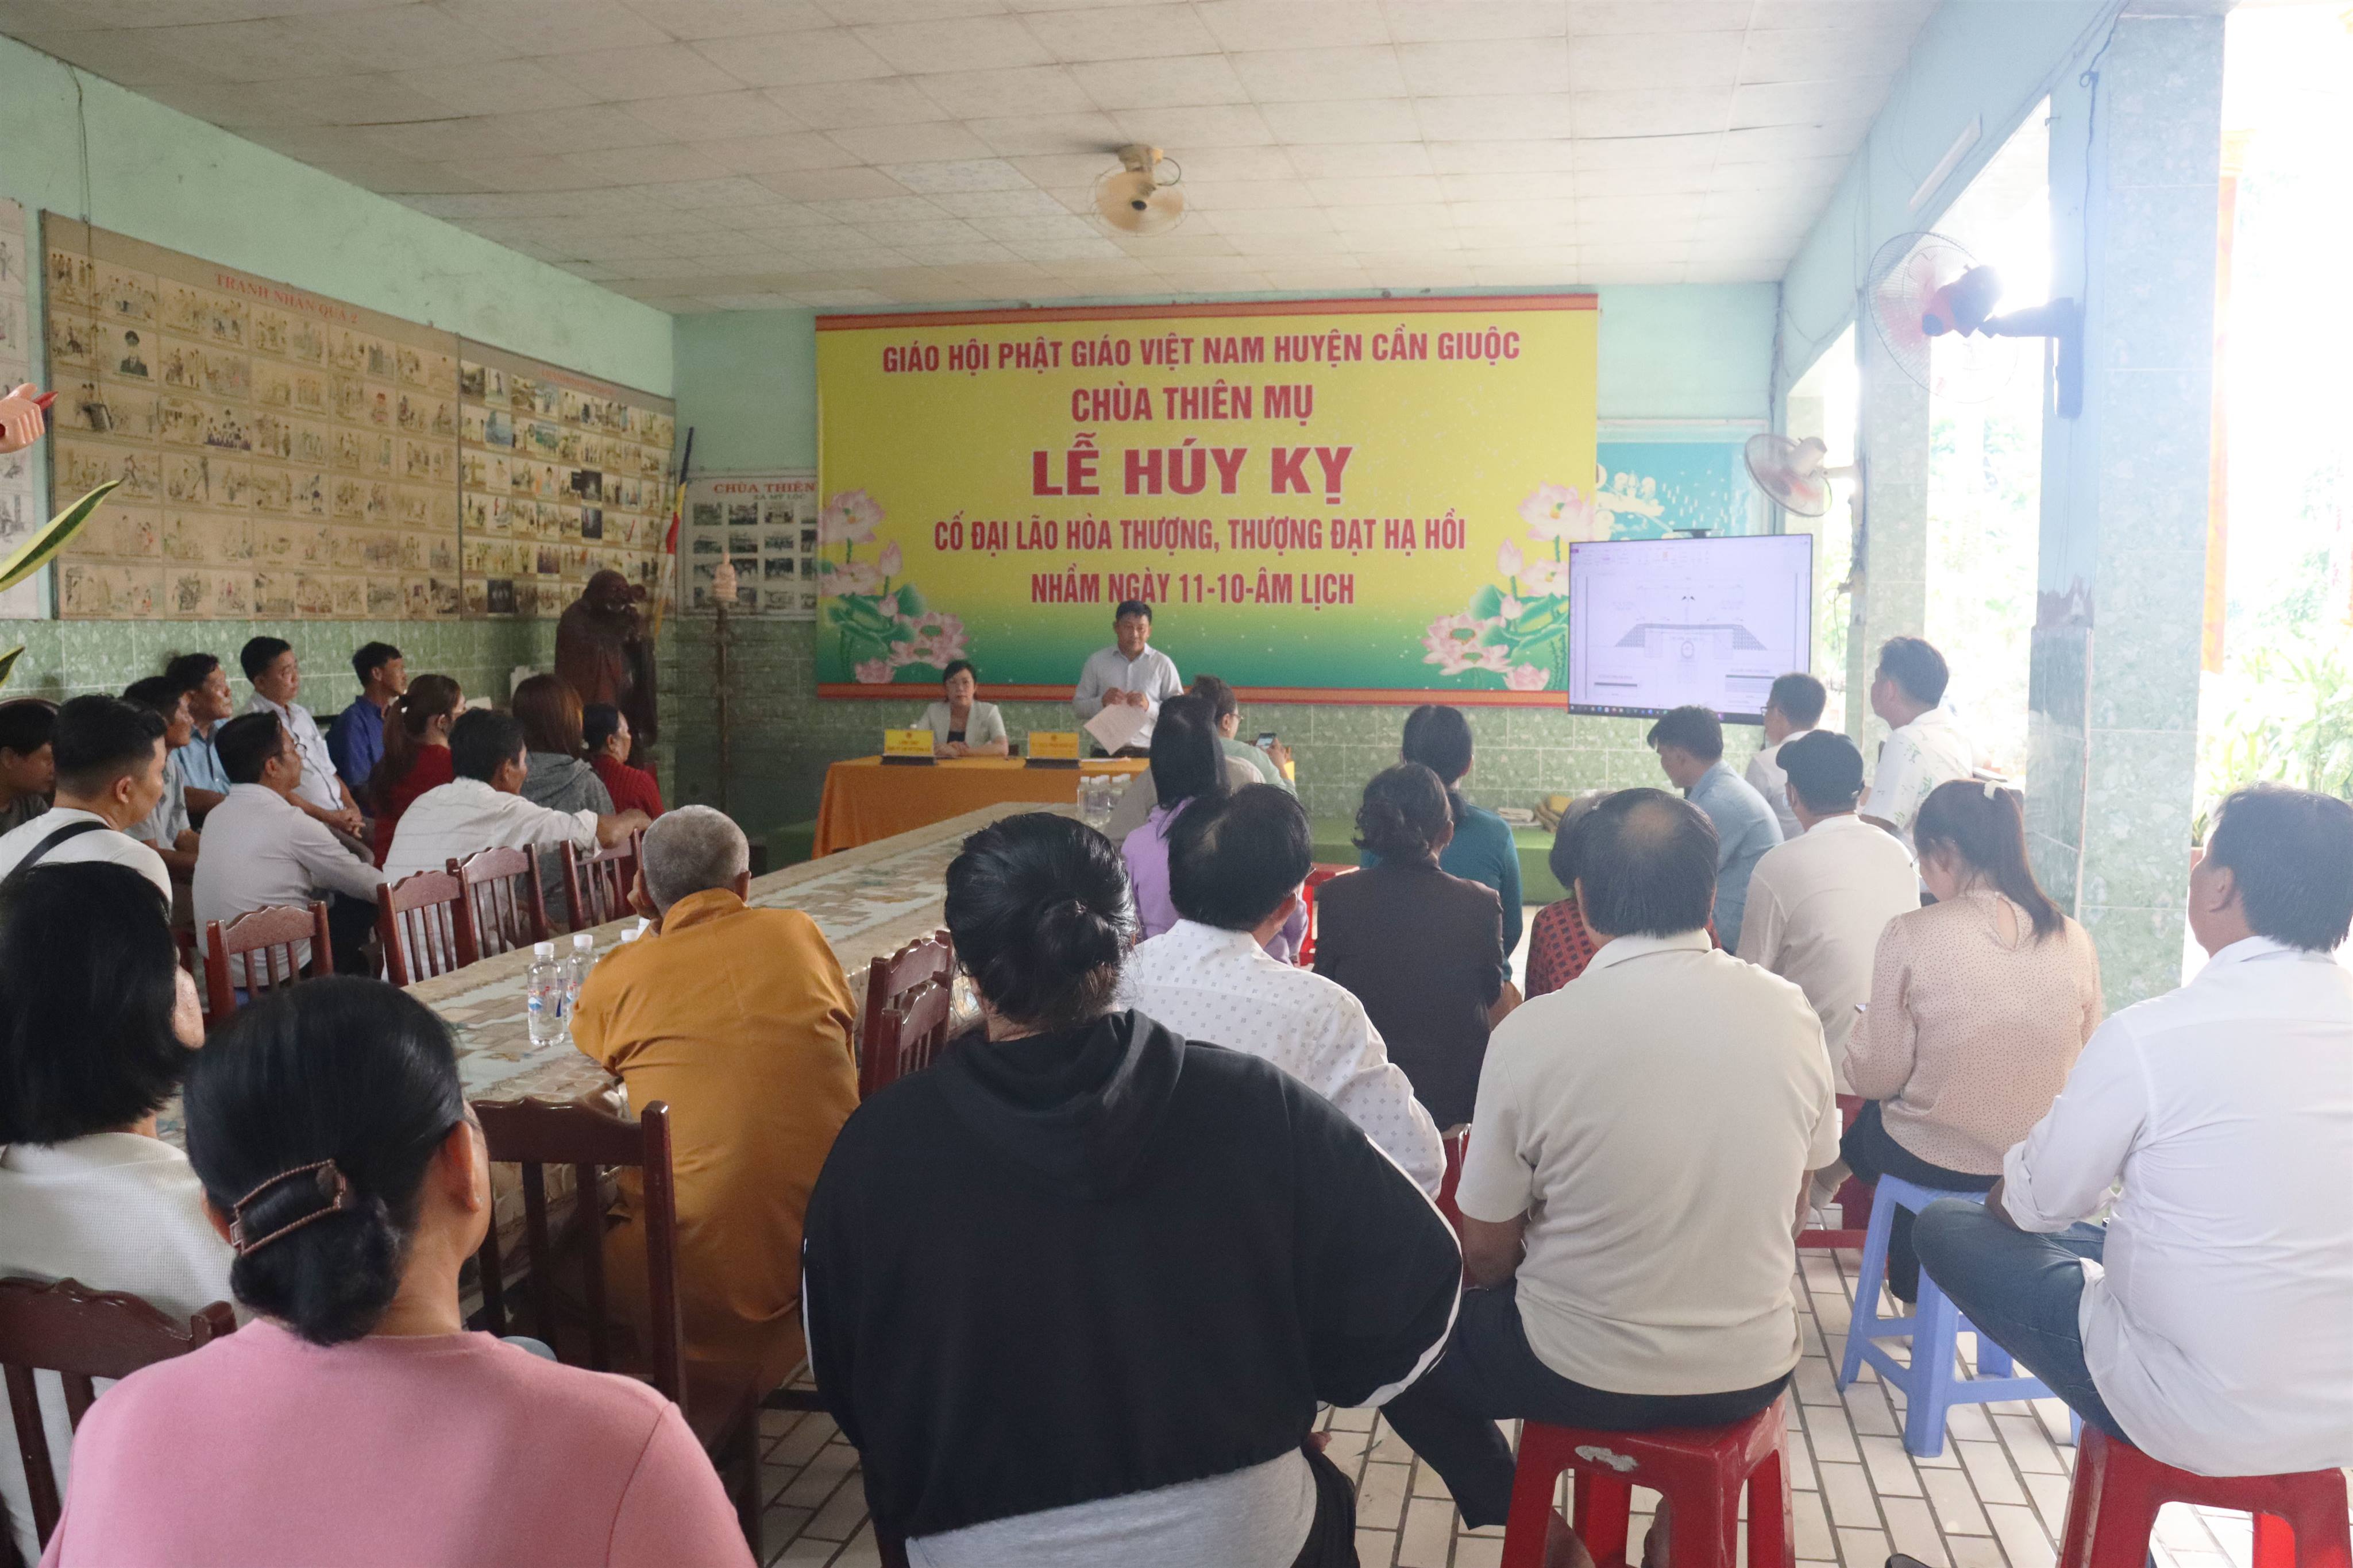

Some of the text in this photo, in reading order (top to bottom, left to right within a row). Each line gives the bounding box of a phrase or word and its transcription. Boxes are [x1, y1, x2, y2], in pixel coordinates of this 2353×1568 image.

[883, 324, 1520, 376] GIÁO HỘI PHẬT GIÁO VIỆT NAM HUYỆN CẦN GIUỘC
[1072, 379, 1313, 426] CHÙA THIÊN MỤ
[713, 481, 816, 493] CHÙA THIÊN
[1033, 432, 1353, 505] LỄ HÚY KỴ
[935, 508, 1465, 557] CỐ ĐẠI LÃO HÒA THƯỢNG, THƯỢNG ĐẠT HẠ HỒI
[1032, 564, 1355, 611] NHẦM NGÀY 11-10-ÂM LỊCH
